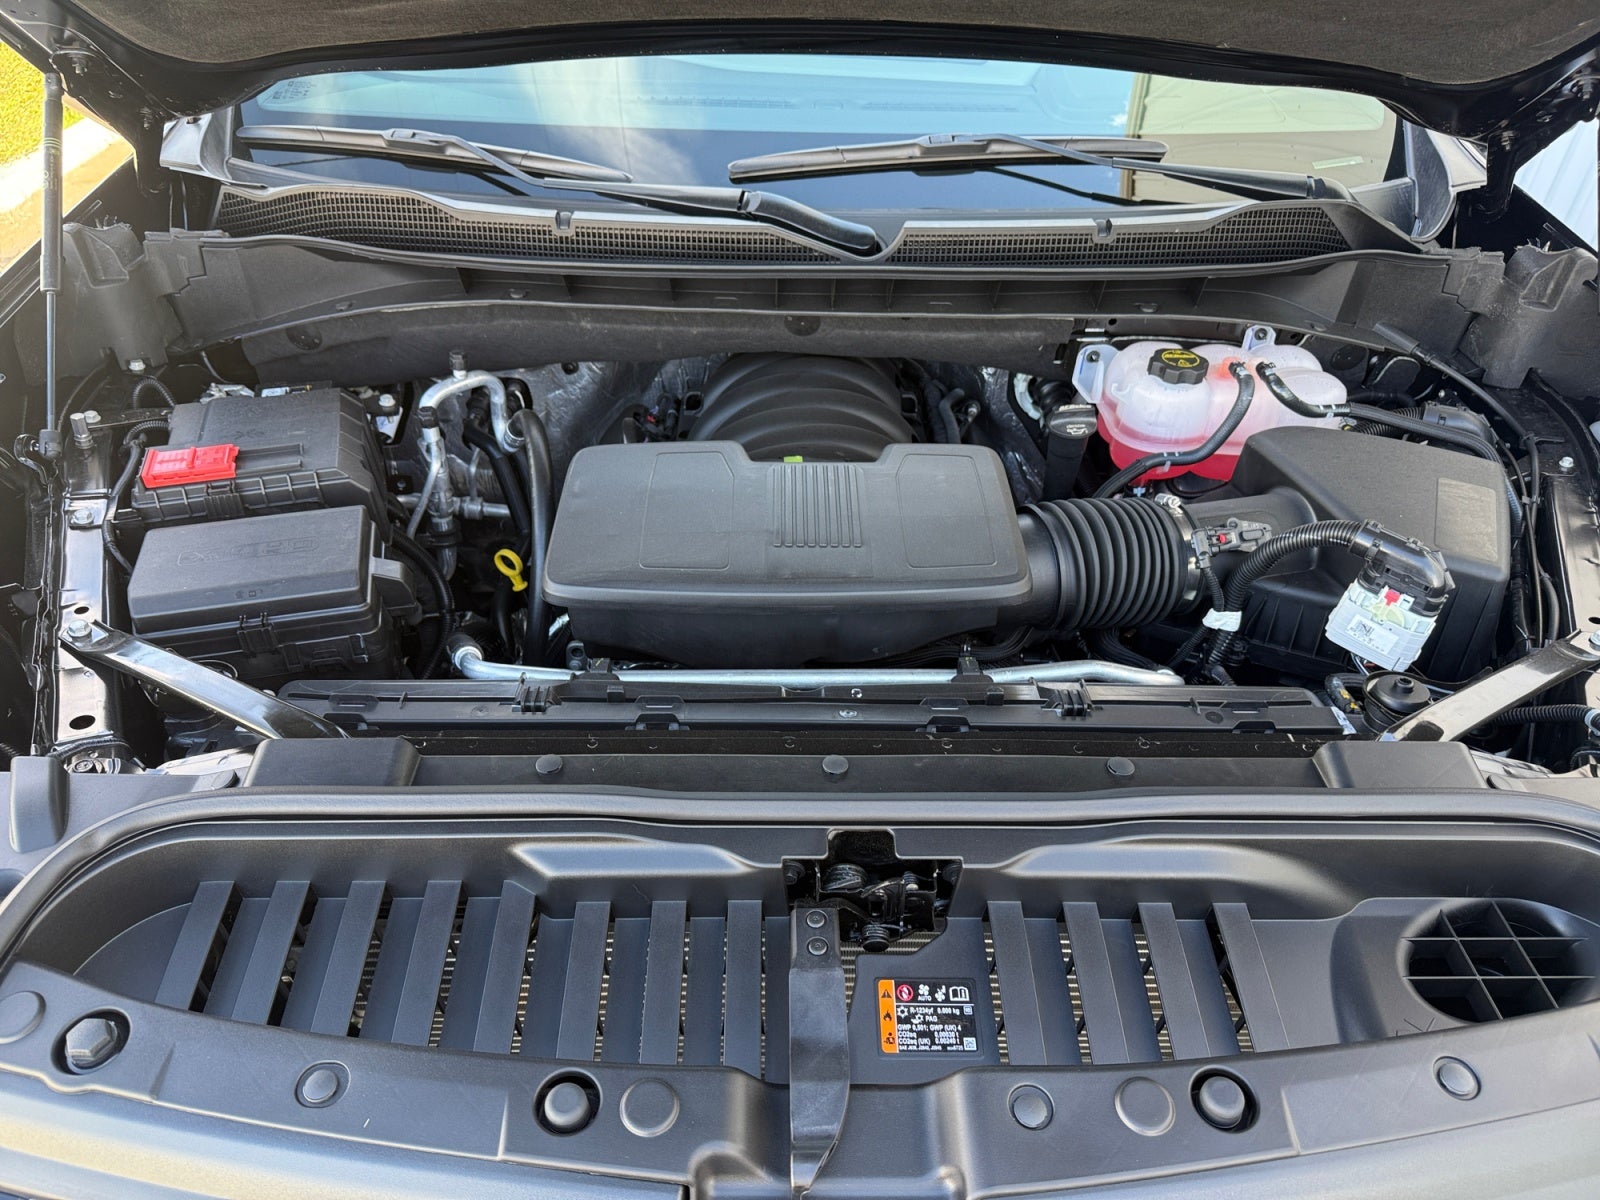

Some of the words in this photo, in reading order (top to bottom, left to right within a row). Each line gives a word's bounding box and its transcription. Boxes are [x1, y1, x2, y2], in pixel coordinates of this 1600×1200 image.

[909, 1006, 934, 1015] R-1234yf
[953, 1007, 960, 1015] kg
[944, 1024, 957, 1032] (UK)
[918, 1038, 931, 1046] (UK)
